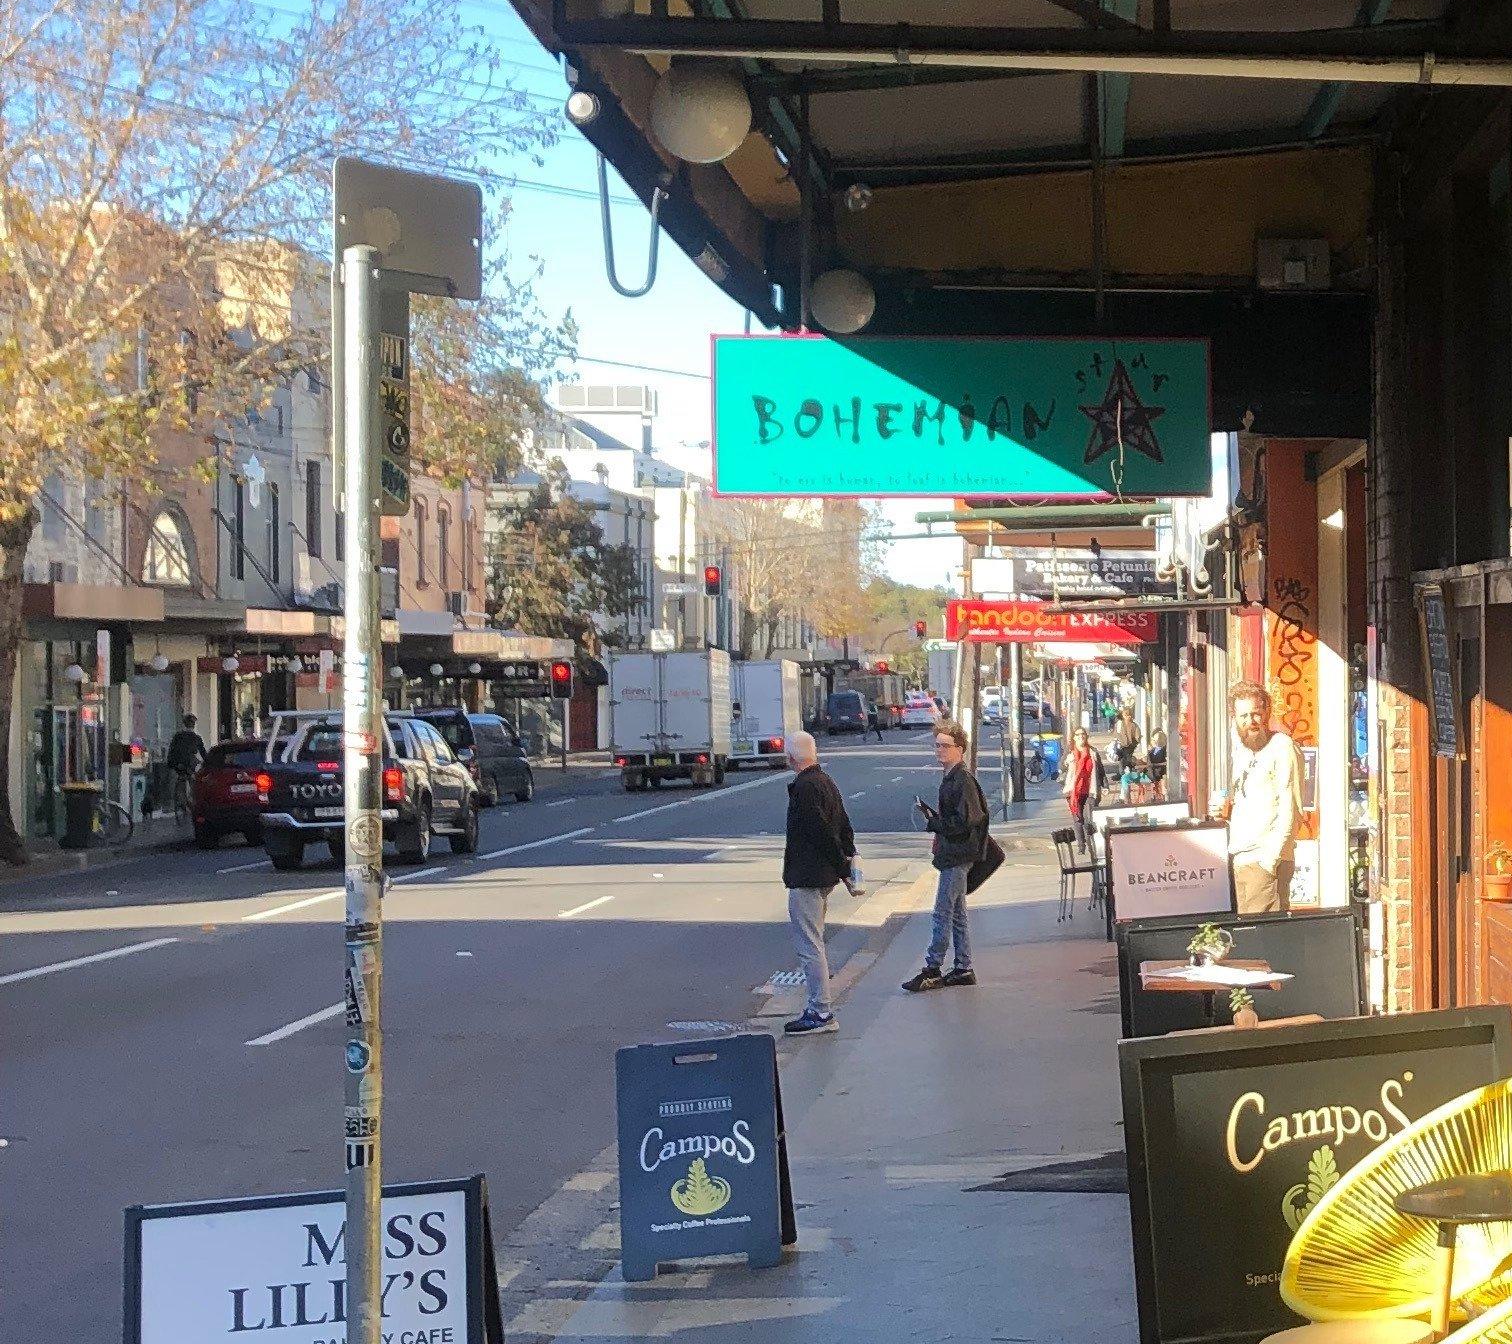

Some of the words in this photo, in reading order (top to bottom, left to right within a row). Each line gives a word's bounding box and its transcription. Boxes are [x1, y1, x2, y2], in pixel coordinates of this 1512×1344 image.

[1070, 612, 1149, 627] EXPRESS
[289, 783, 343, 799] TOYO
[1127, 867, 1216, 886] BEANCRAFT
[302, 1211, 447, 1267] MSS
[1245, 1270, 1282, 1287] Speci
